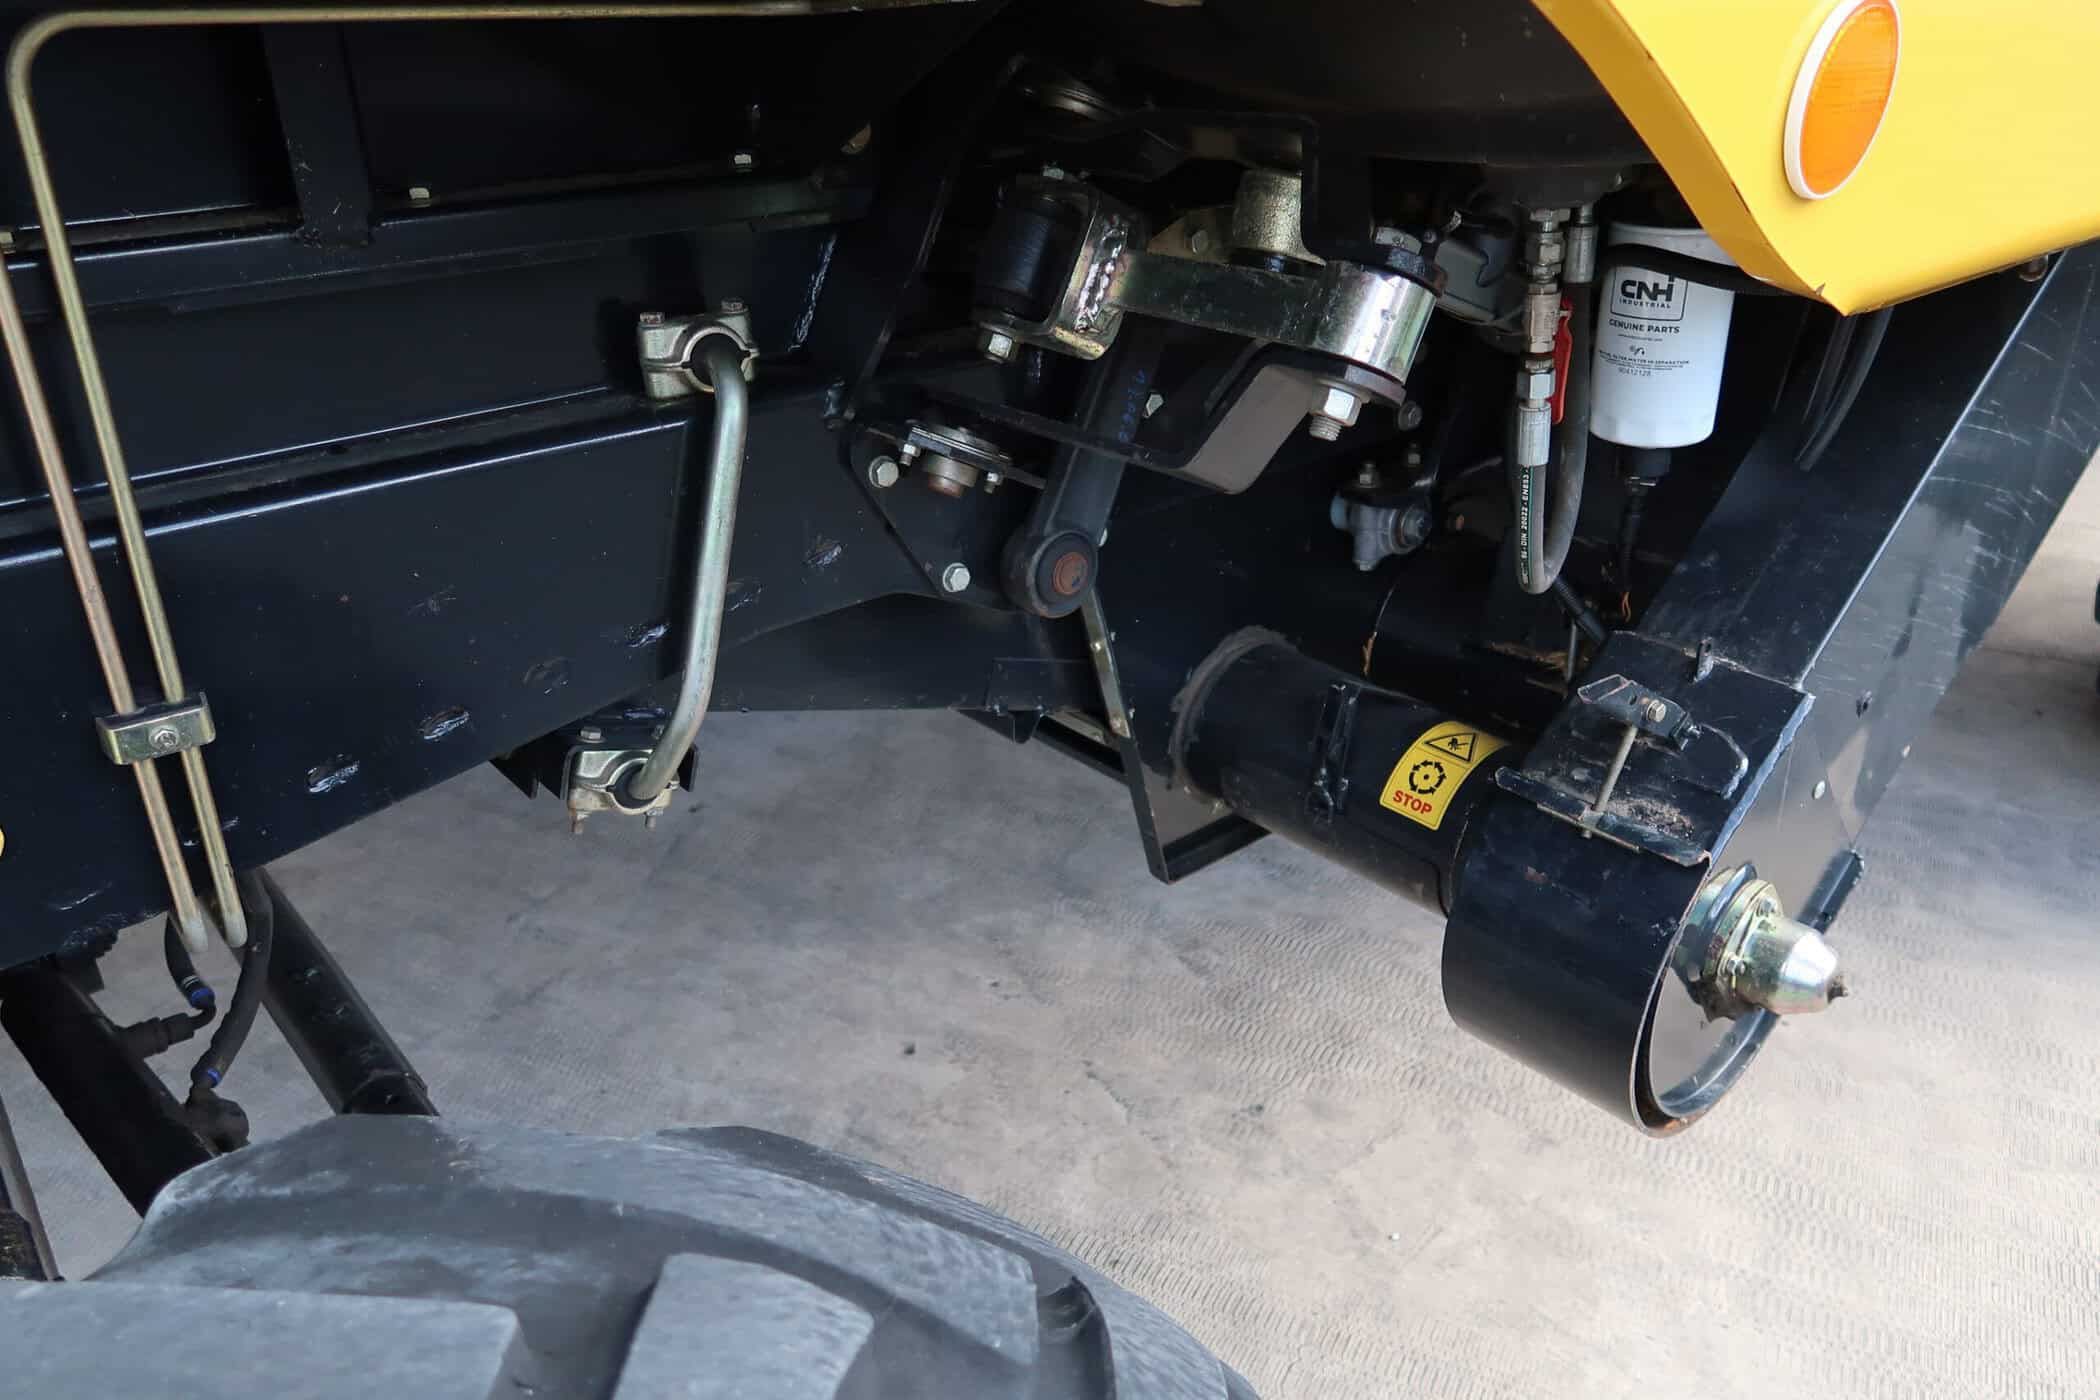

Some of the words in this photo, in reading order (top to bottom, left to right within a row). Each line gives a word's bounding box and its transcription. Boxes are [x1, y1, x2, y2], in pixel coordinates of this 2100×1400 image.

[1621, 279, 1674, 302] CNH
[1619, 299, 1671, 309] INDUSTRIAL
[1608, 319, 1645, 332] GENUINE
[1647, 324, 1680, 334] PARTS
[1392, 790, 1432, 814] STOP
